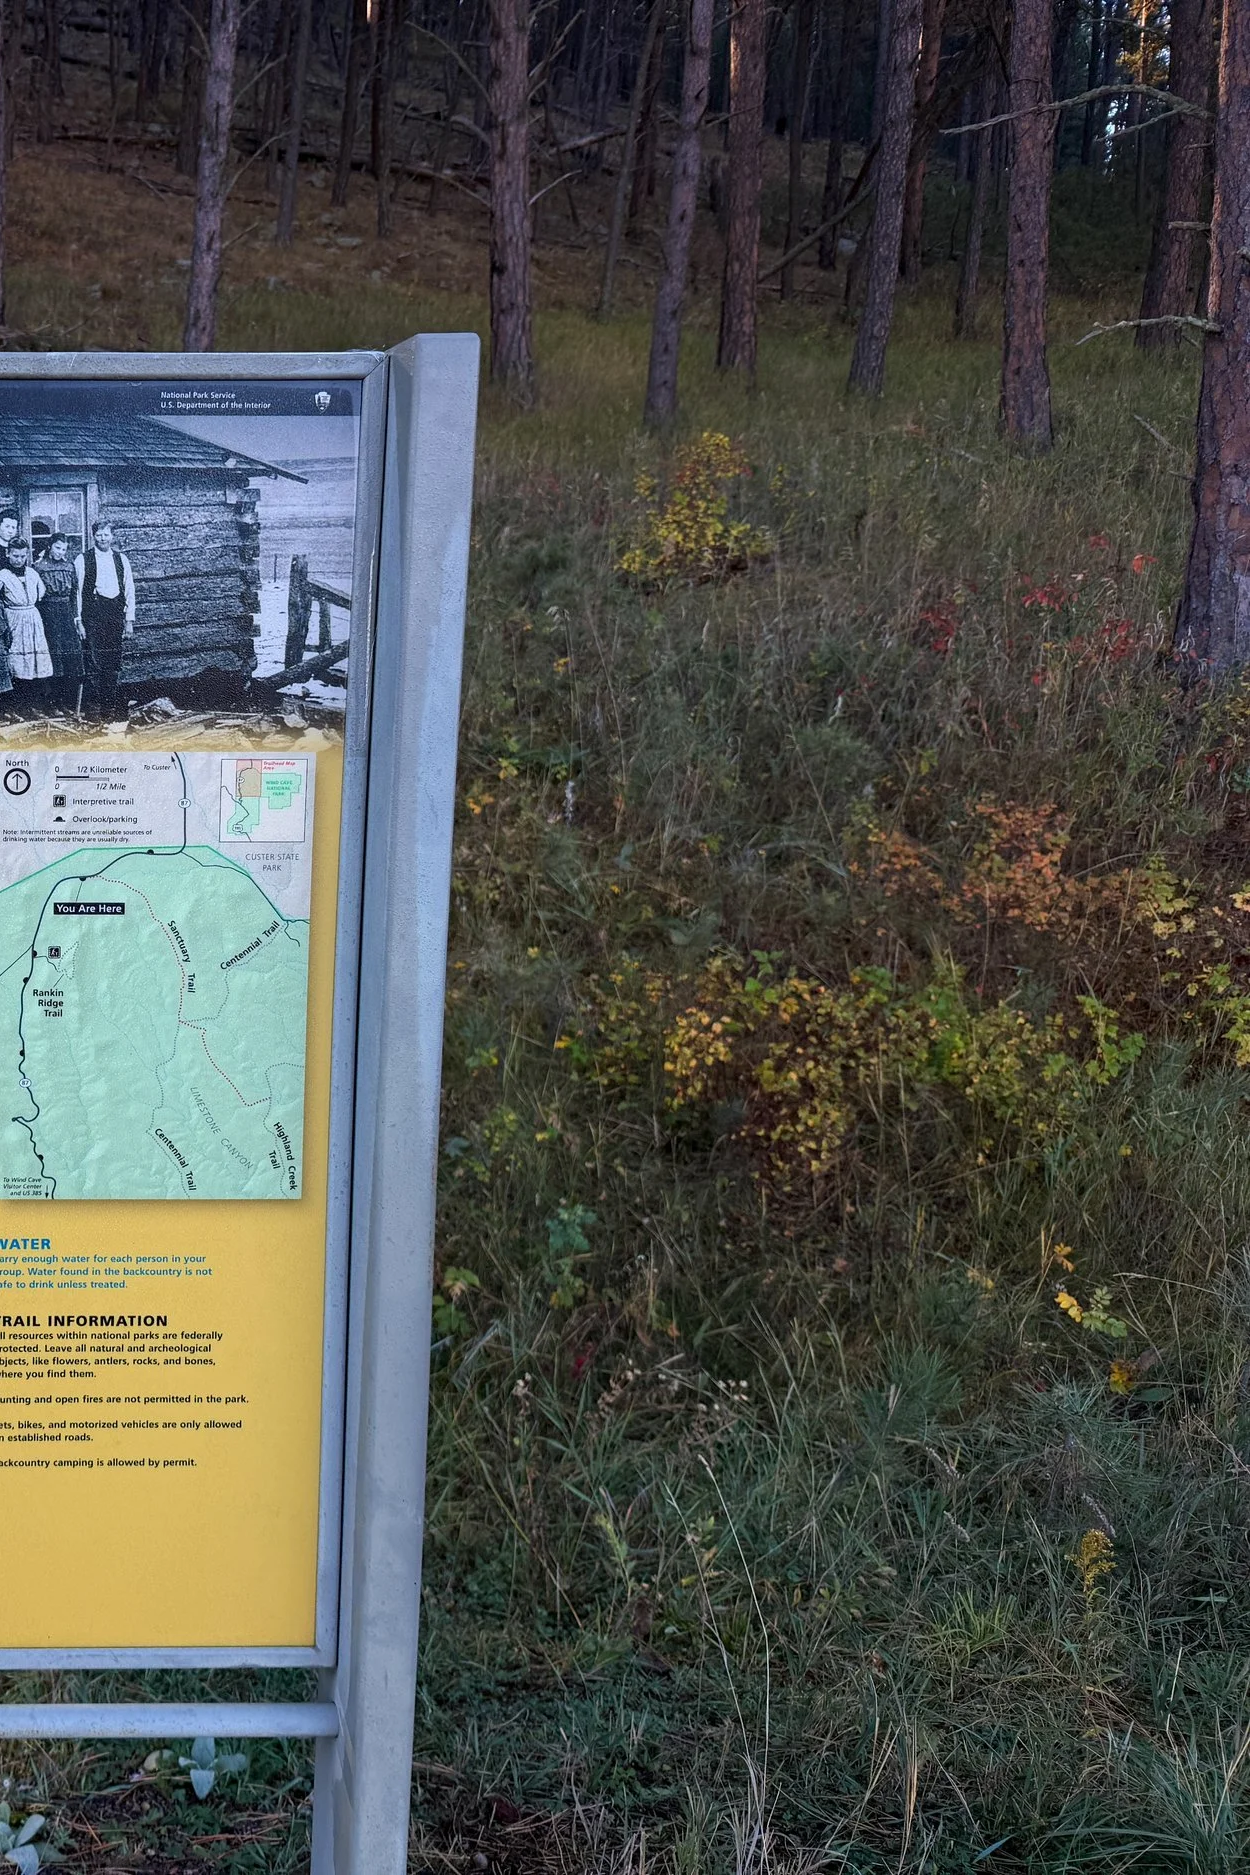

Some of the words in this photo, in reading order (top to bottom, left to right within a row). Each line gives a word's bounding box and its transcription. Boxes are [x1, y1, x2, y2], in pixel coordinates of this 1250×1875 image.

[210, 391, 235, 399] Service
[160, 400, 174, 408] U.S.
[176, 401, 219, 410] Department
[77, 765, 88, 773] 1/2
[89, 765, 127, 773] Kilometer
[96, 782, 107, 790] 1/2
[109, 782, 126, 790] Mile
[72, 798, 116, 806] Interpretive
[118, 797, 134, 805] trail
[72, 815, 137, 824] Overlook/parking
[277, 853, 299, 861] STATE
[56, 904, 75, 912] You
[78, 904, 95, 912] Are
[98, 904, 122, 913] Here
[220, 937, 263, 971] Centennial
[262, 920, 281, 938] Trail
[167, 920, 192, 963] Sanctuary
[187, 972, 196, 993] Trail
[32, 988, 63, 997] Rankin
[37, 998, 63, 1009] Ridge
[43, 1008, 62, 1017] Trail
[190, 1086, 221, 1135] LIMESTONE
[220, 1138, 254, 1170] CANYON
[154, 1127, 188, 1168] Centennial
[186, 1170, 197, 1191] Trail
[268, 1149, 281, 1170] Trail
[273, 1121, 294, 1161] Highland
[288, 1165, 297, 1190] Creek
[21, 1254, 58, 1264] enough
[93, 1253, 107, 1262] for
[110, 1254, 132, 1263] each
[135, 1256, 168, 1264] person
[171, 1254, 180, 1262] in
[183, 1256, 206, 1264] your
[48, 1315, 167, 1326] INFORMATION
[56, 1330, 87, 1339] within
[90, 1330, 130, 1339] national
[133, 1330, 159, 1341] parks
[180, 1330, 223, 1341] federally
[53, 1458, 93, 1468] camping
[96, 1457, 104, 1466] is
[106, 1457, 145, 1466] allowed
[148, 1457, 160, 1468] by
[163, 1458, 196, 1468] permit.
